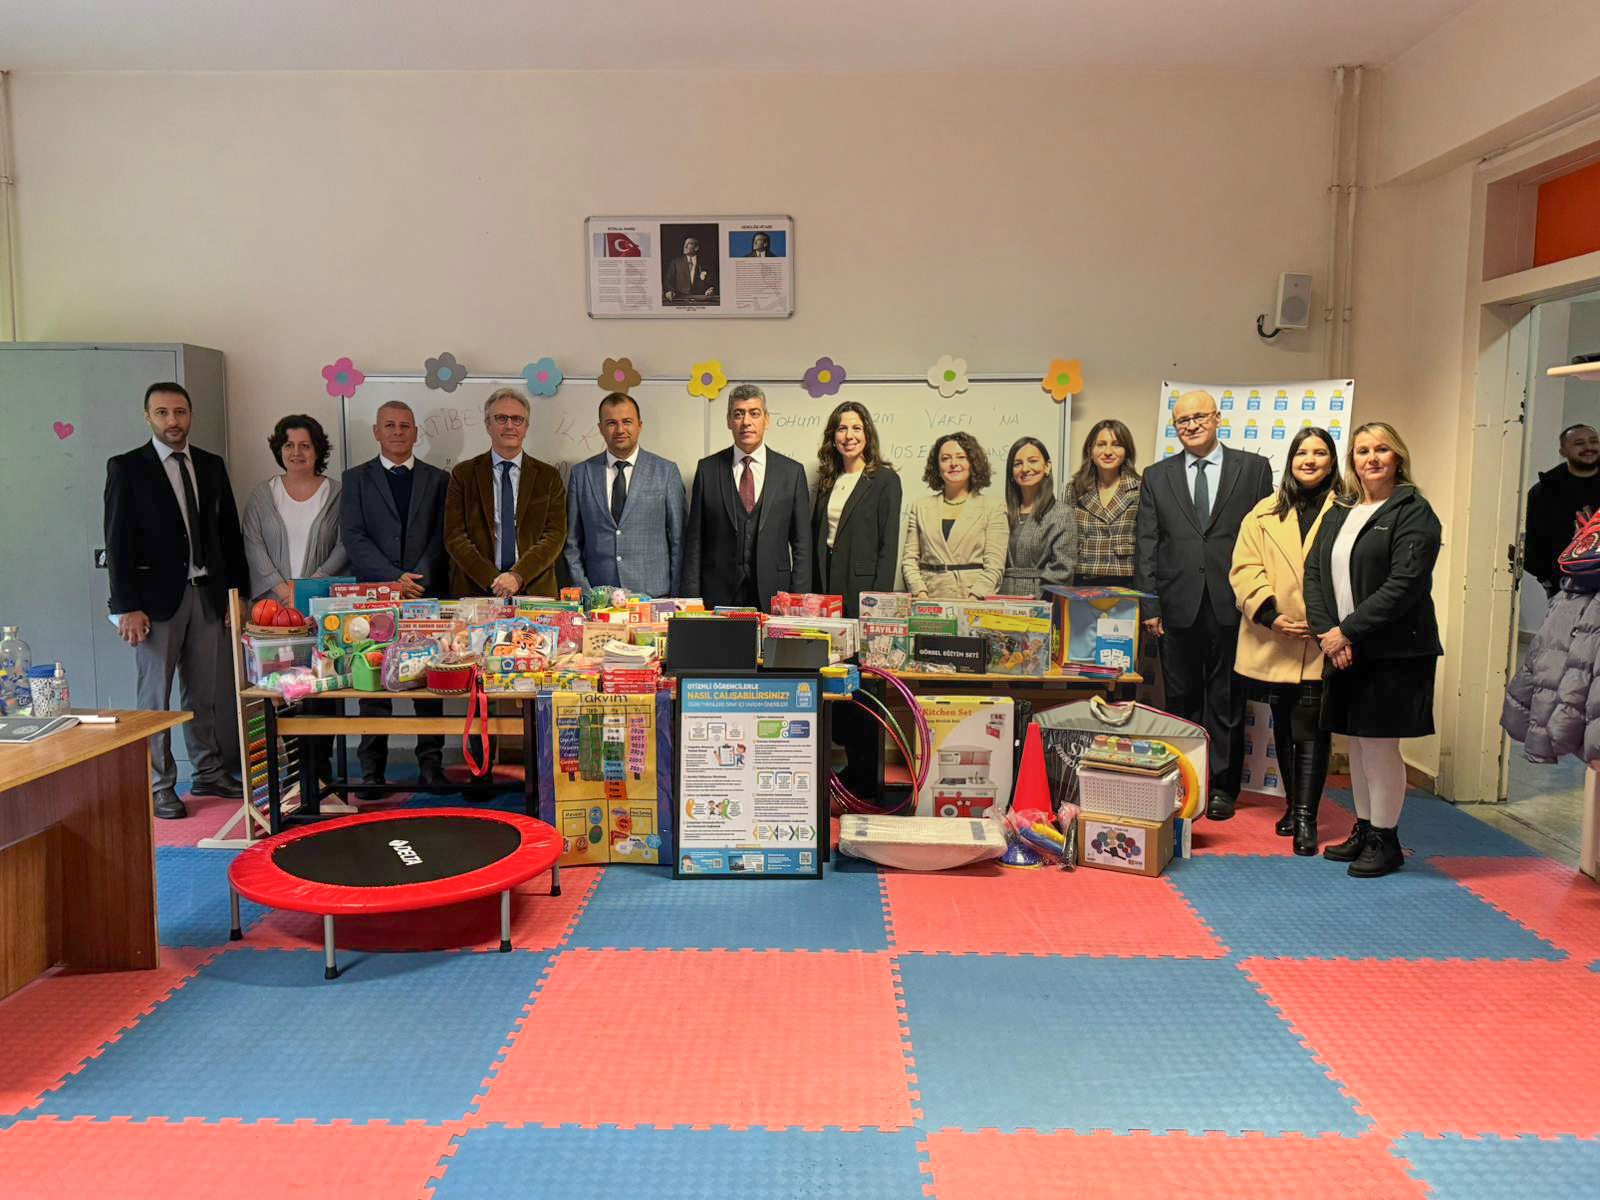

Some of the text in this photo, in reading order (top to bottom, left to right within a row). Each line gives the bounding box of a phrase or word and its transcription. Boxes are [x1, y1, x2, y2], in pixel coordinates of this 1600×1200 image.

[687, 682, 760, 690] OTİZMLİ ÖĞRENCİLERLE
[687, 690, 790, 701] NASIL ÇALIŞABİLİRSİNİZ?
[922, 708, 973, 717] Kitchen Set
